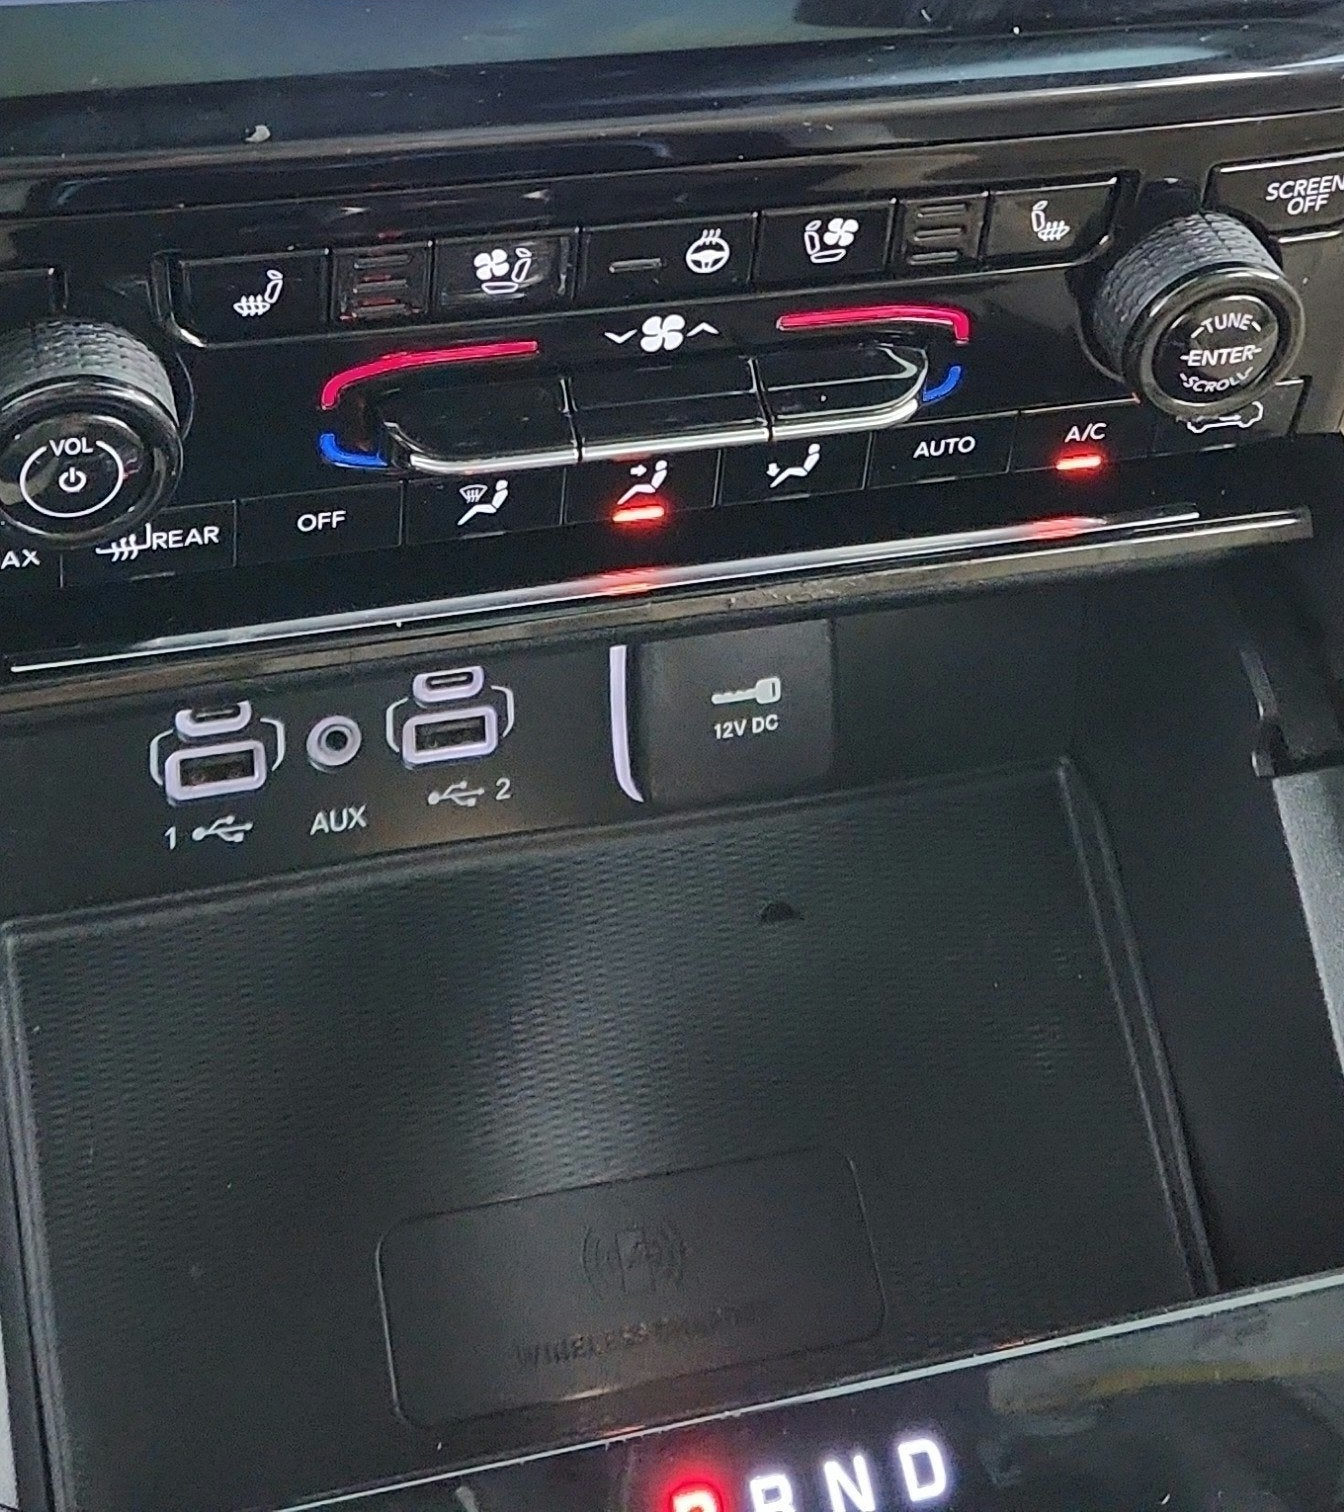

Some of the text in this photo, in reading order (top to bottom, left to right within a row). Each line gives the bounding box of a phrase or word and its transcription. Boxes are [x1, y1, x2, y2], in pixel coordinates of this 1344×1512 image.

[1287, 193, 1330, 216] OFF
[1200, 312, 1254, 334] TUNE
[1187, 344, 1256, 367] ENTER
[1182, 370, 1248, 393] SCROLL
[1064, 422, 1108, 443] A/C
[48, 437, 93, 456] VOL
[913, 435, 977, 459] AUTO
[296, 509, 348, 534] OFF
[150, 524, 220, 550] REAR
[713, 714, 780, 741] 12V DC
[495, 778, 512, 801] 2
[309, 806, 367, 836] AUX
[164, 826, 177, 849] 1
[824, 1454, 876, 1512] N
[897, 1438, 947, 1503] D
